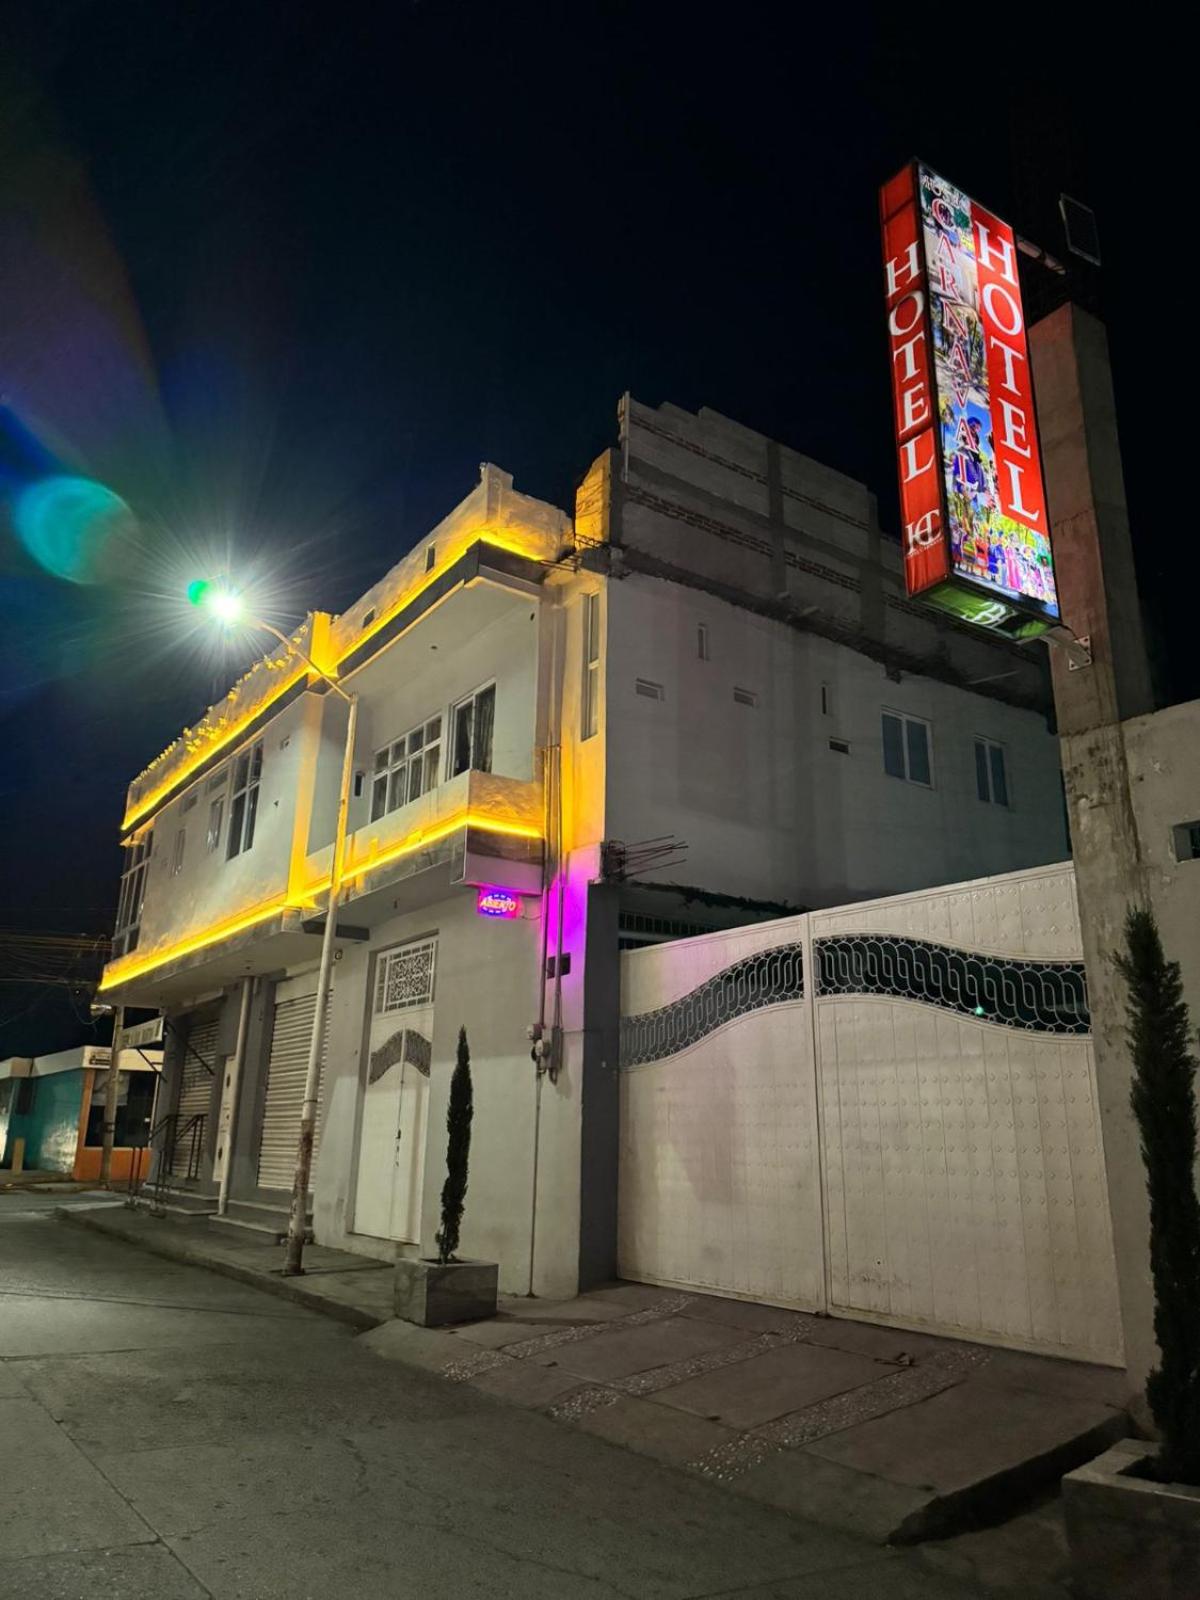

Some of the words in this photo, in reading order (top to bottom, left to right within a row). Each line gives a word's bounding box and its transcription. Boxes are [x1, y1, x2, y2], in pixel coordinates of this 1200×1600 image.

[886, 240, 935, 484] HOTEL
[932, 198, 979, 490] CARNAVAL
[975, 219, 1040, 522] HOTEL
